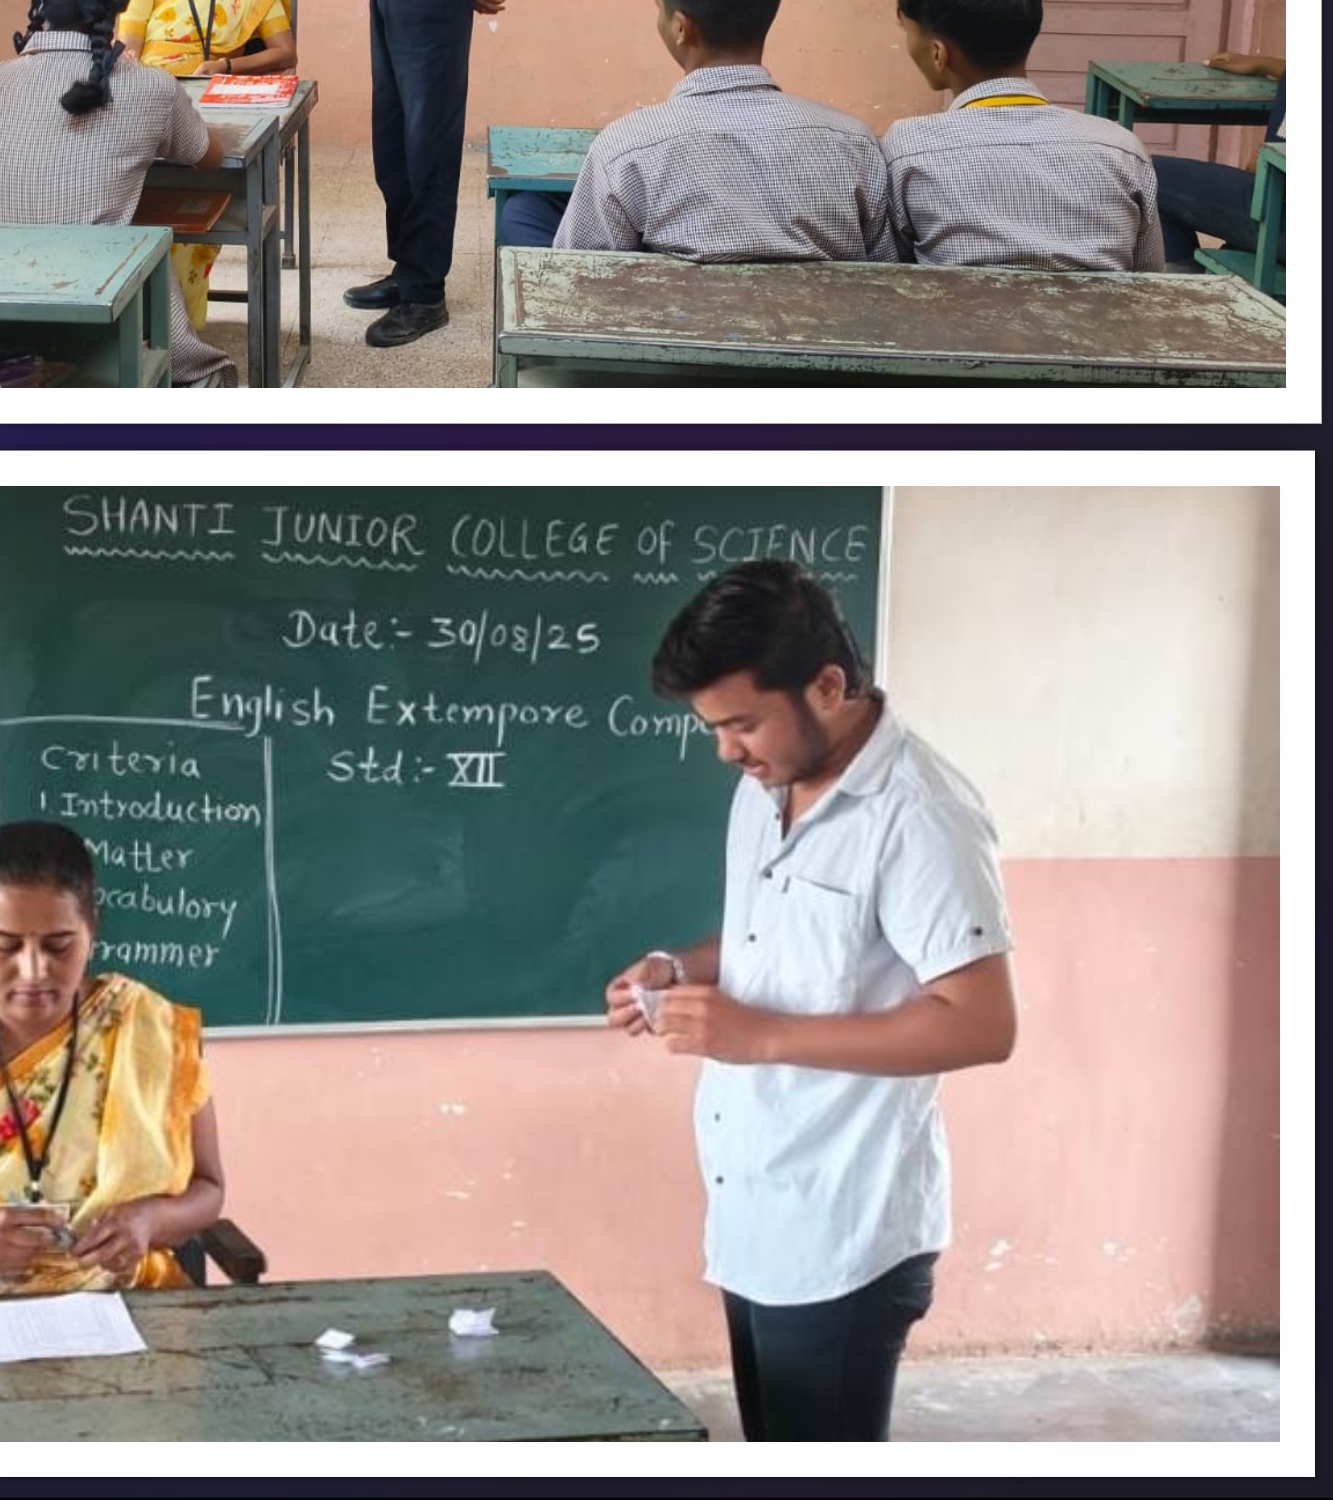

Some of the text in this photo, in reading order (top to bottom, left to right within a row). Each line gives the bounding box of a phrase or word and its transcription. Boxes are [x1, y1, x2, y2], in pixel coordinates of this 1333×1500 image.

[63, 495, 235, 537] SHANTI
[261, 506, 426, 555] JUNIOR
[451, 514, 621, 560] COLLEGE
[691, 524, 869, 563] SCIENCE
[426, 609, 602, 664] 30/08/25
[191, 676, 335, 737] English
[367, 685, 590, 747] Extempore
[41, 740, 201, 779] Criteria
[447, 752, 506, 788] XII
[60, 791, 261, 828] Introduction
[83, 838, 194, 873] Matter
[94, 882, 237, 940] ocabulory
[90, 940, 221, 968] rammer
